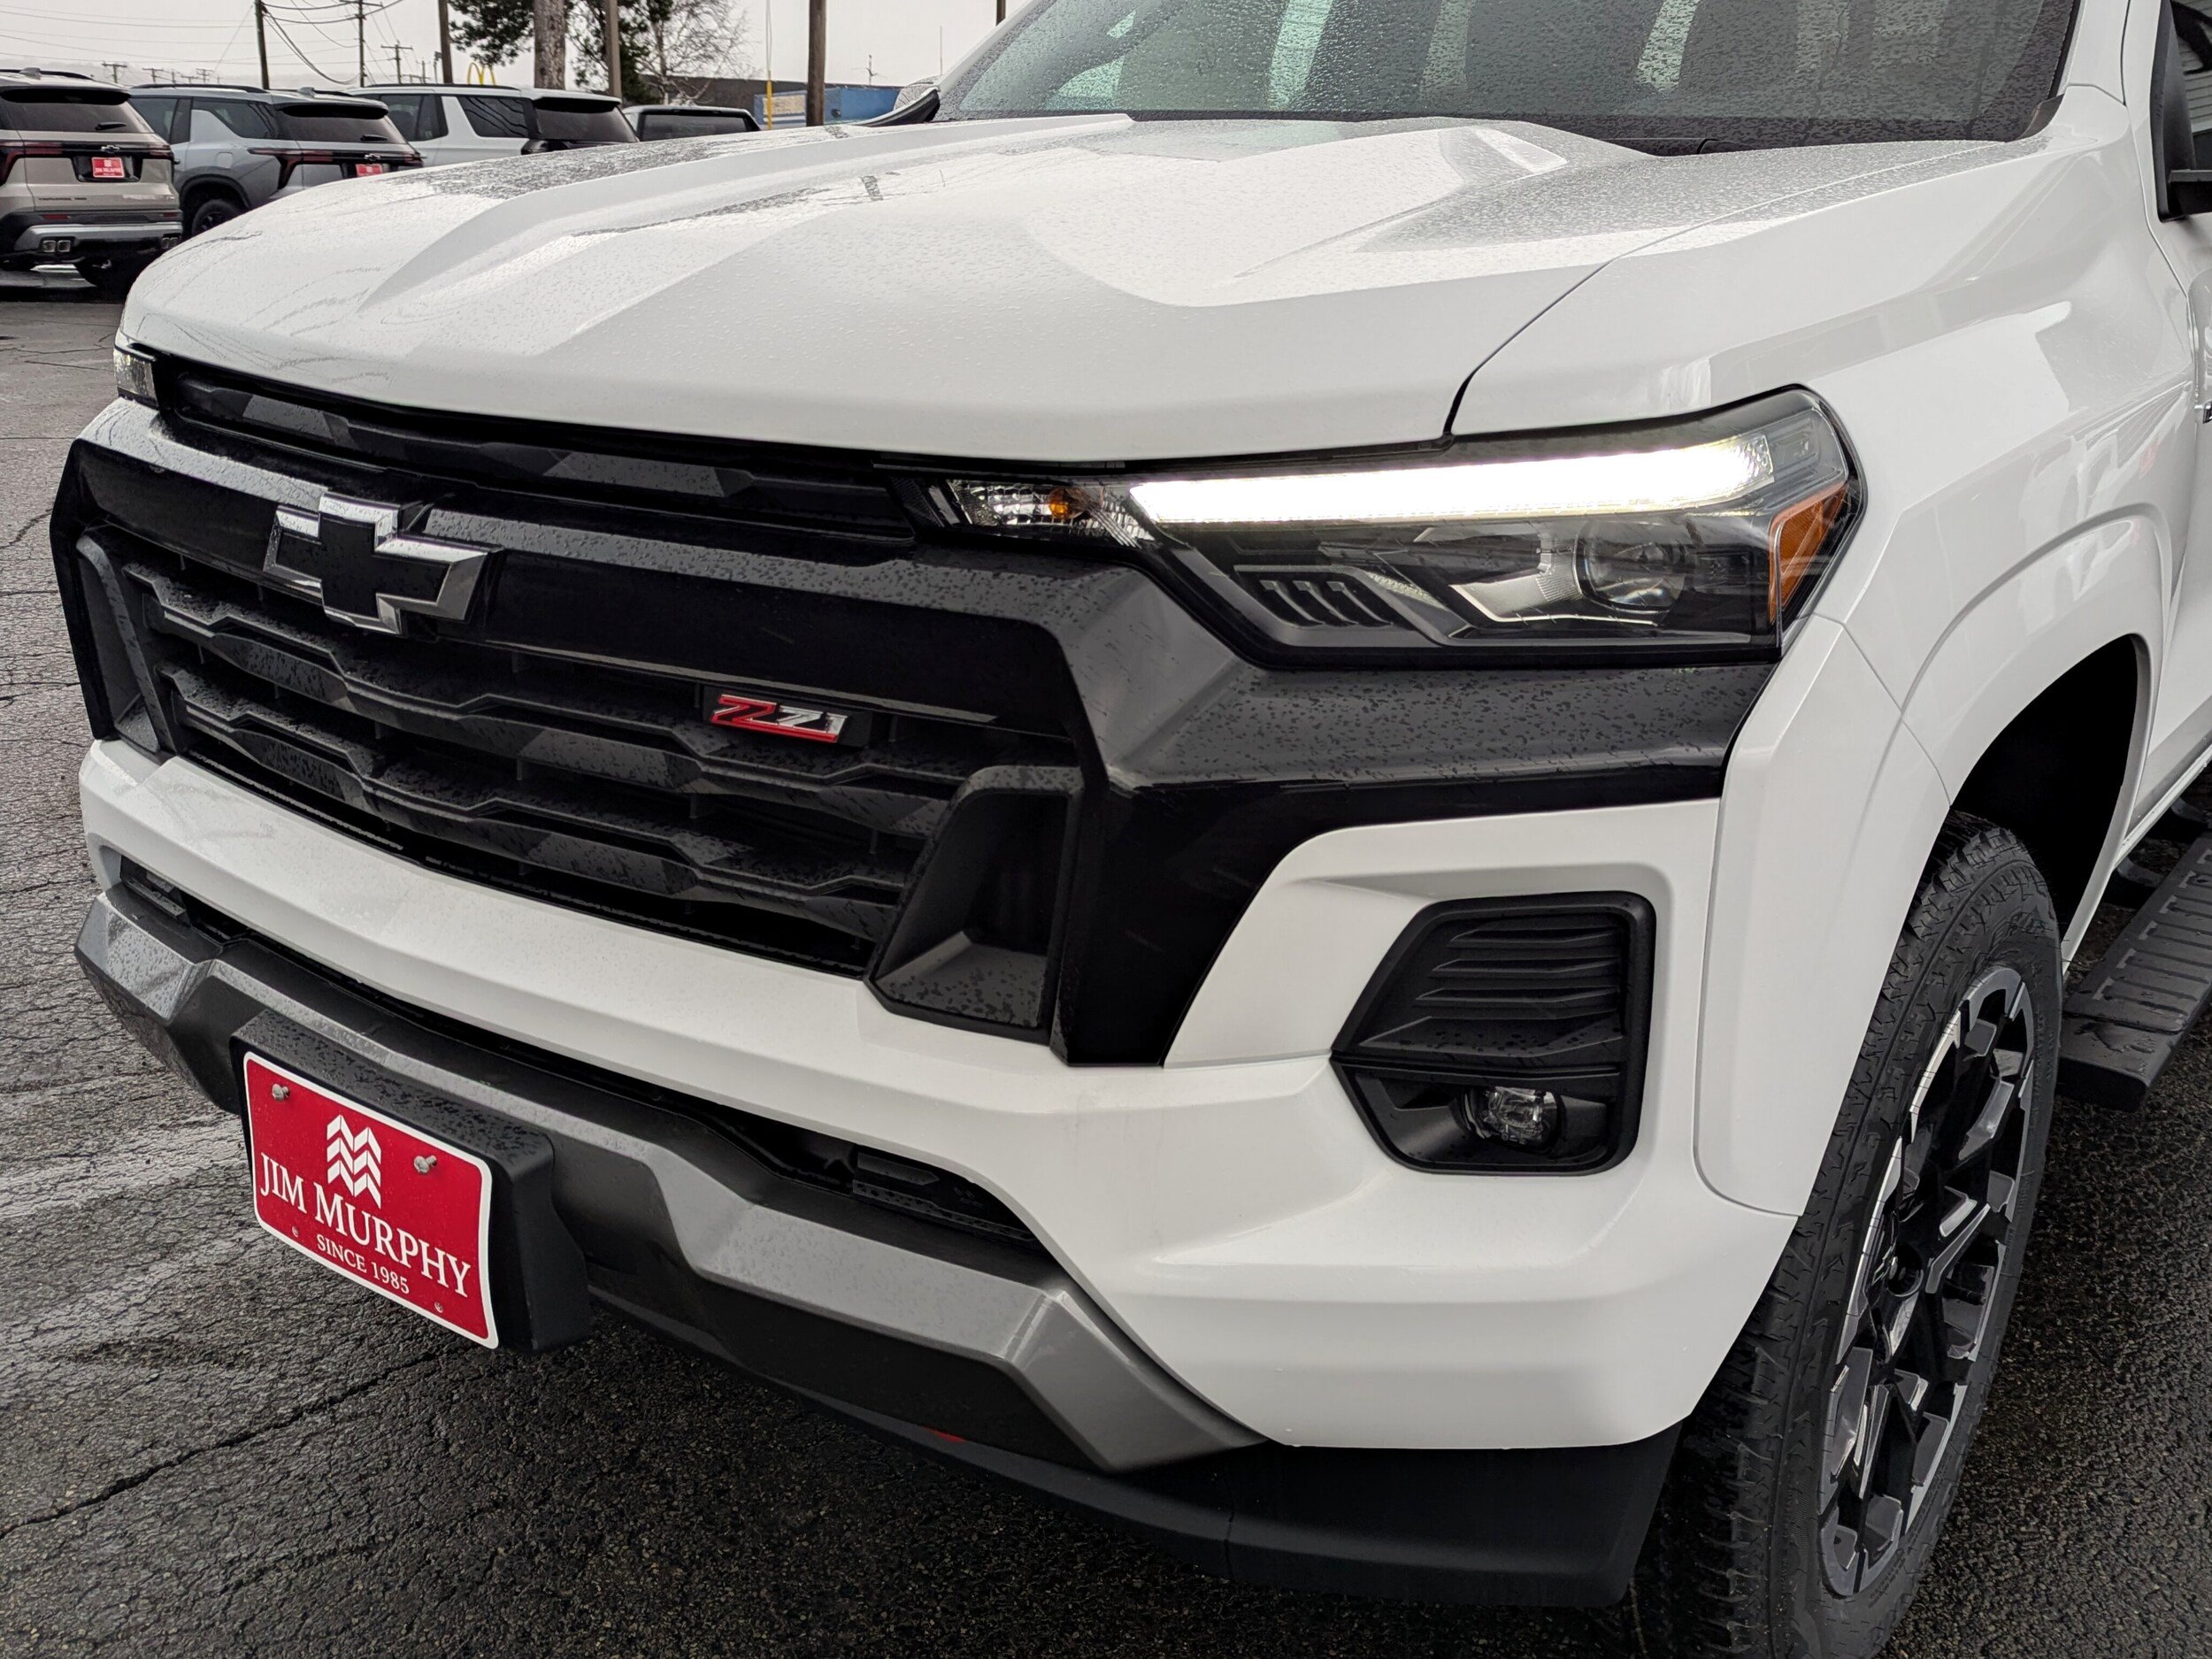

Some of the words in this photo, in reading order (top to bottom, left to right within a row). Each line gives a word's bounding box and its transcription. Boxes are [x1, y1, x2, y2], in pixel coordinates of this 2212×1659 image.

[710, 695, 848, 743] Z71
[260, 1152, 307, 1214] JIM
[313, 1182, 472, 1298] MURPHY
[316, 1234, 367, 1273] SINCE
[371, 1262, 410, 1294] 1985
